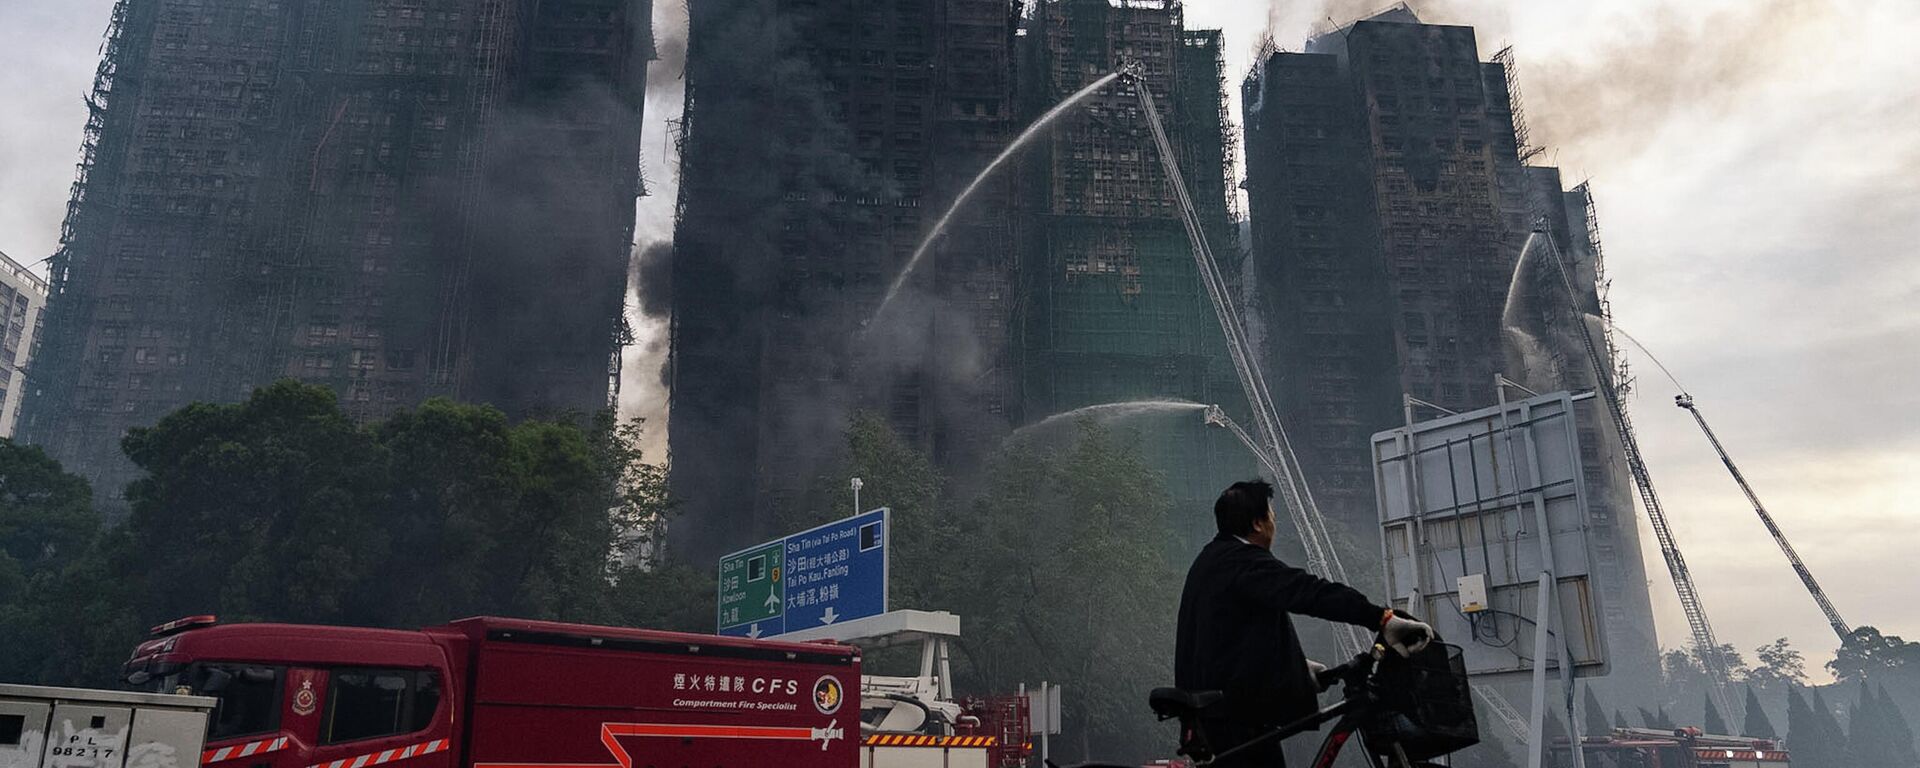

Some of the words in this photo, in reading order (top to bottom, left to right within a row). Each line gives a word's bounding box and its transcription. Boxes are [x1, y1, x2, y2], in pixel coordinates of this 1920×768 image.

[787, 542, 800, 553] Sha
[801, 538, 811, 550] Tin
[831, 532, 839, 541] Po
[723, 562, 734, 573] Sha
[723, 576, 739, 592] 沙田
[787, 576, 797, 588] Tai
[798, 574, 807, 585] Po
[722, 607, 739, 625] 九龍
[673, 673, 745, 692] 煙火特遣隊
[752, 677, 798, 695] CFS
[673, 698, 737, 709] Compartment
[738, 701, 755, 709] Fire
[756, 701, 797, 710] Specialist
[52, 746, 113, 758] 98217
